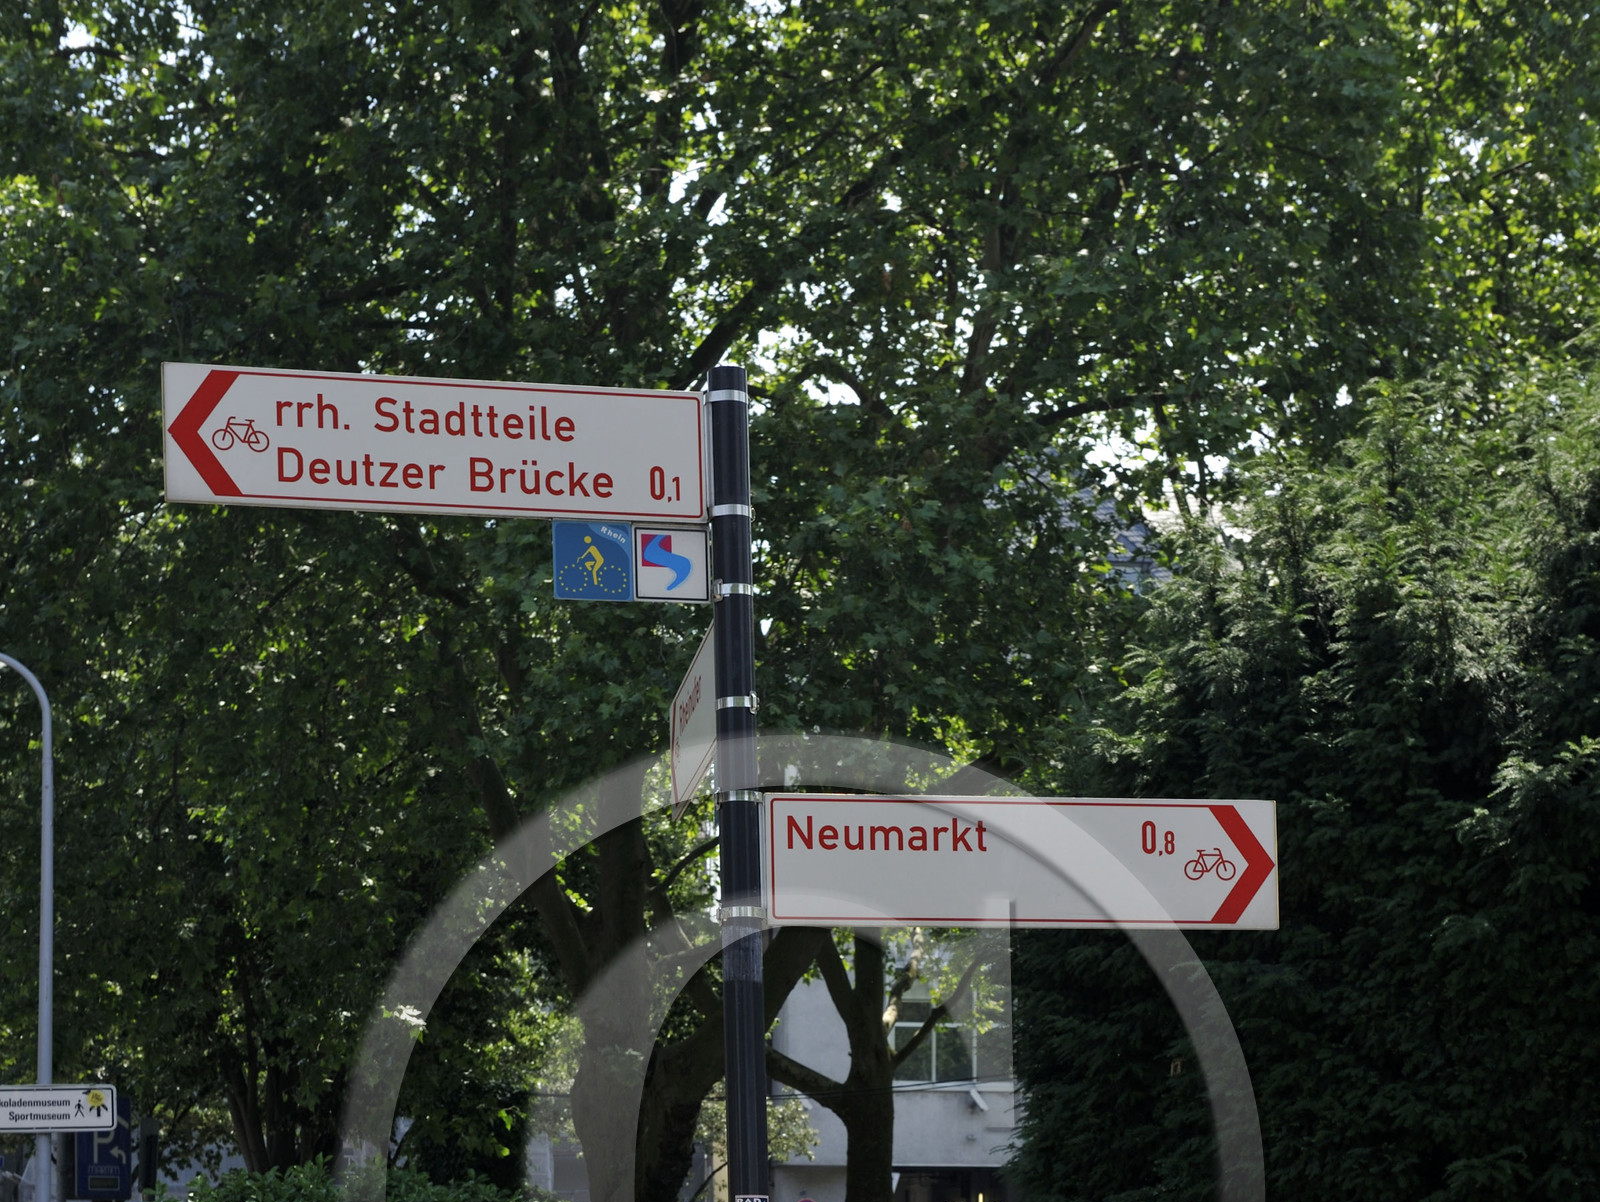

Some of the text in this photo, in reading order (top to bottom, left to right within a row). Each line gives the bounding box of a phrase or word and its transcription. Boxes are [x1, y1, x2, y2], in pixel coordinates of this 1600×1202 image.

[276, 393, 576, 442] rrh. Stadtteile
[277, 446, 681, 502] Deutzer Brücke 0,1
[600, 525, 627, 545] Rhein
[787, 815, 1176, 856] Neumarkt 0,8
[9, 1111, 71, 1122] Sportmuseum
